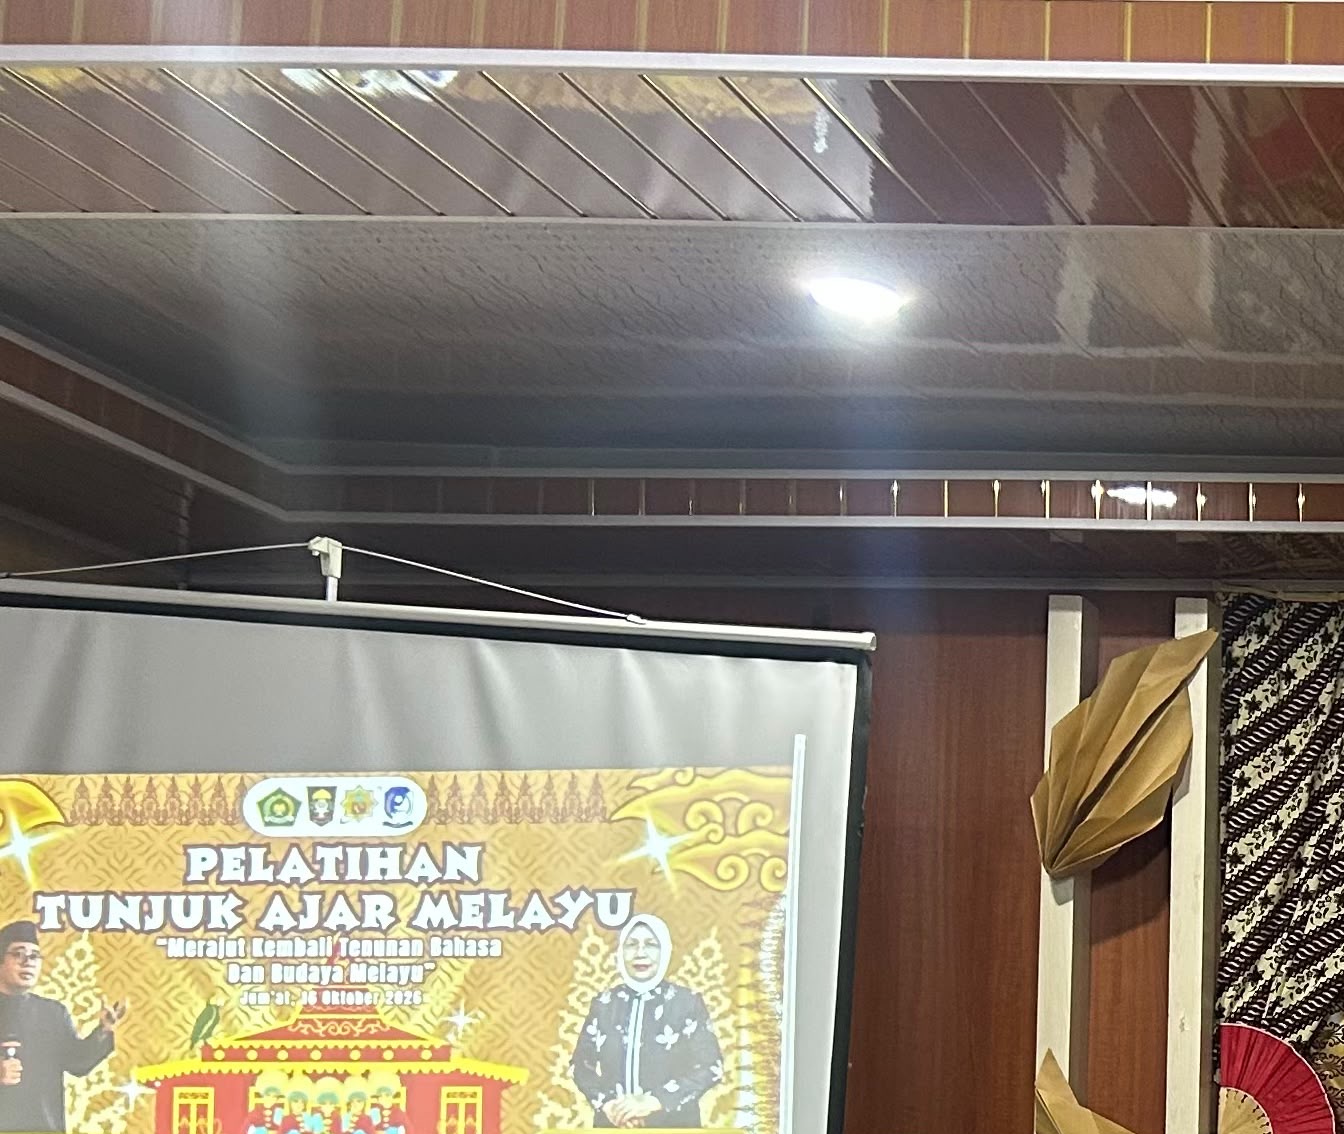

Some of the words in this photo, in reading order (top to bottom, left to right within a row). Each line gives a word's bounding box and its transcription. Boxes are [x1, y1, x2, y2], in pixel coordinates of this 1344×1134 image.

[185, 844, 484, 884] PELATIHAN
[35, 888, 246, 931] TUNJUK
[258, 889, 399, 931] AJAR
[411, 887, 634, 932] MELAYU
[251, 936, 333, 958] Kembali
[338, 937, 425, 958] Tenunan
[430, 936, 503, 958] Bahasa
[227, 963, 266, 985] Dan
[271, 963, 345, 987] Budaya
[385, 989, 424, 1006] 2026
